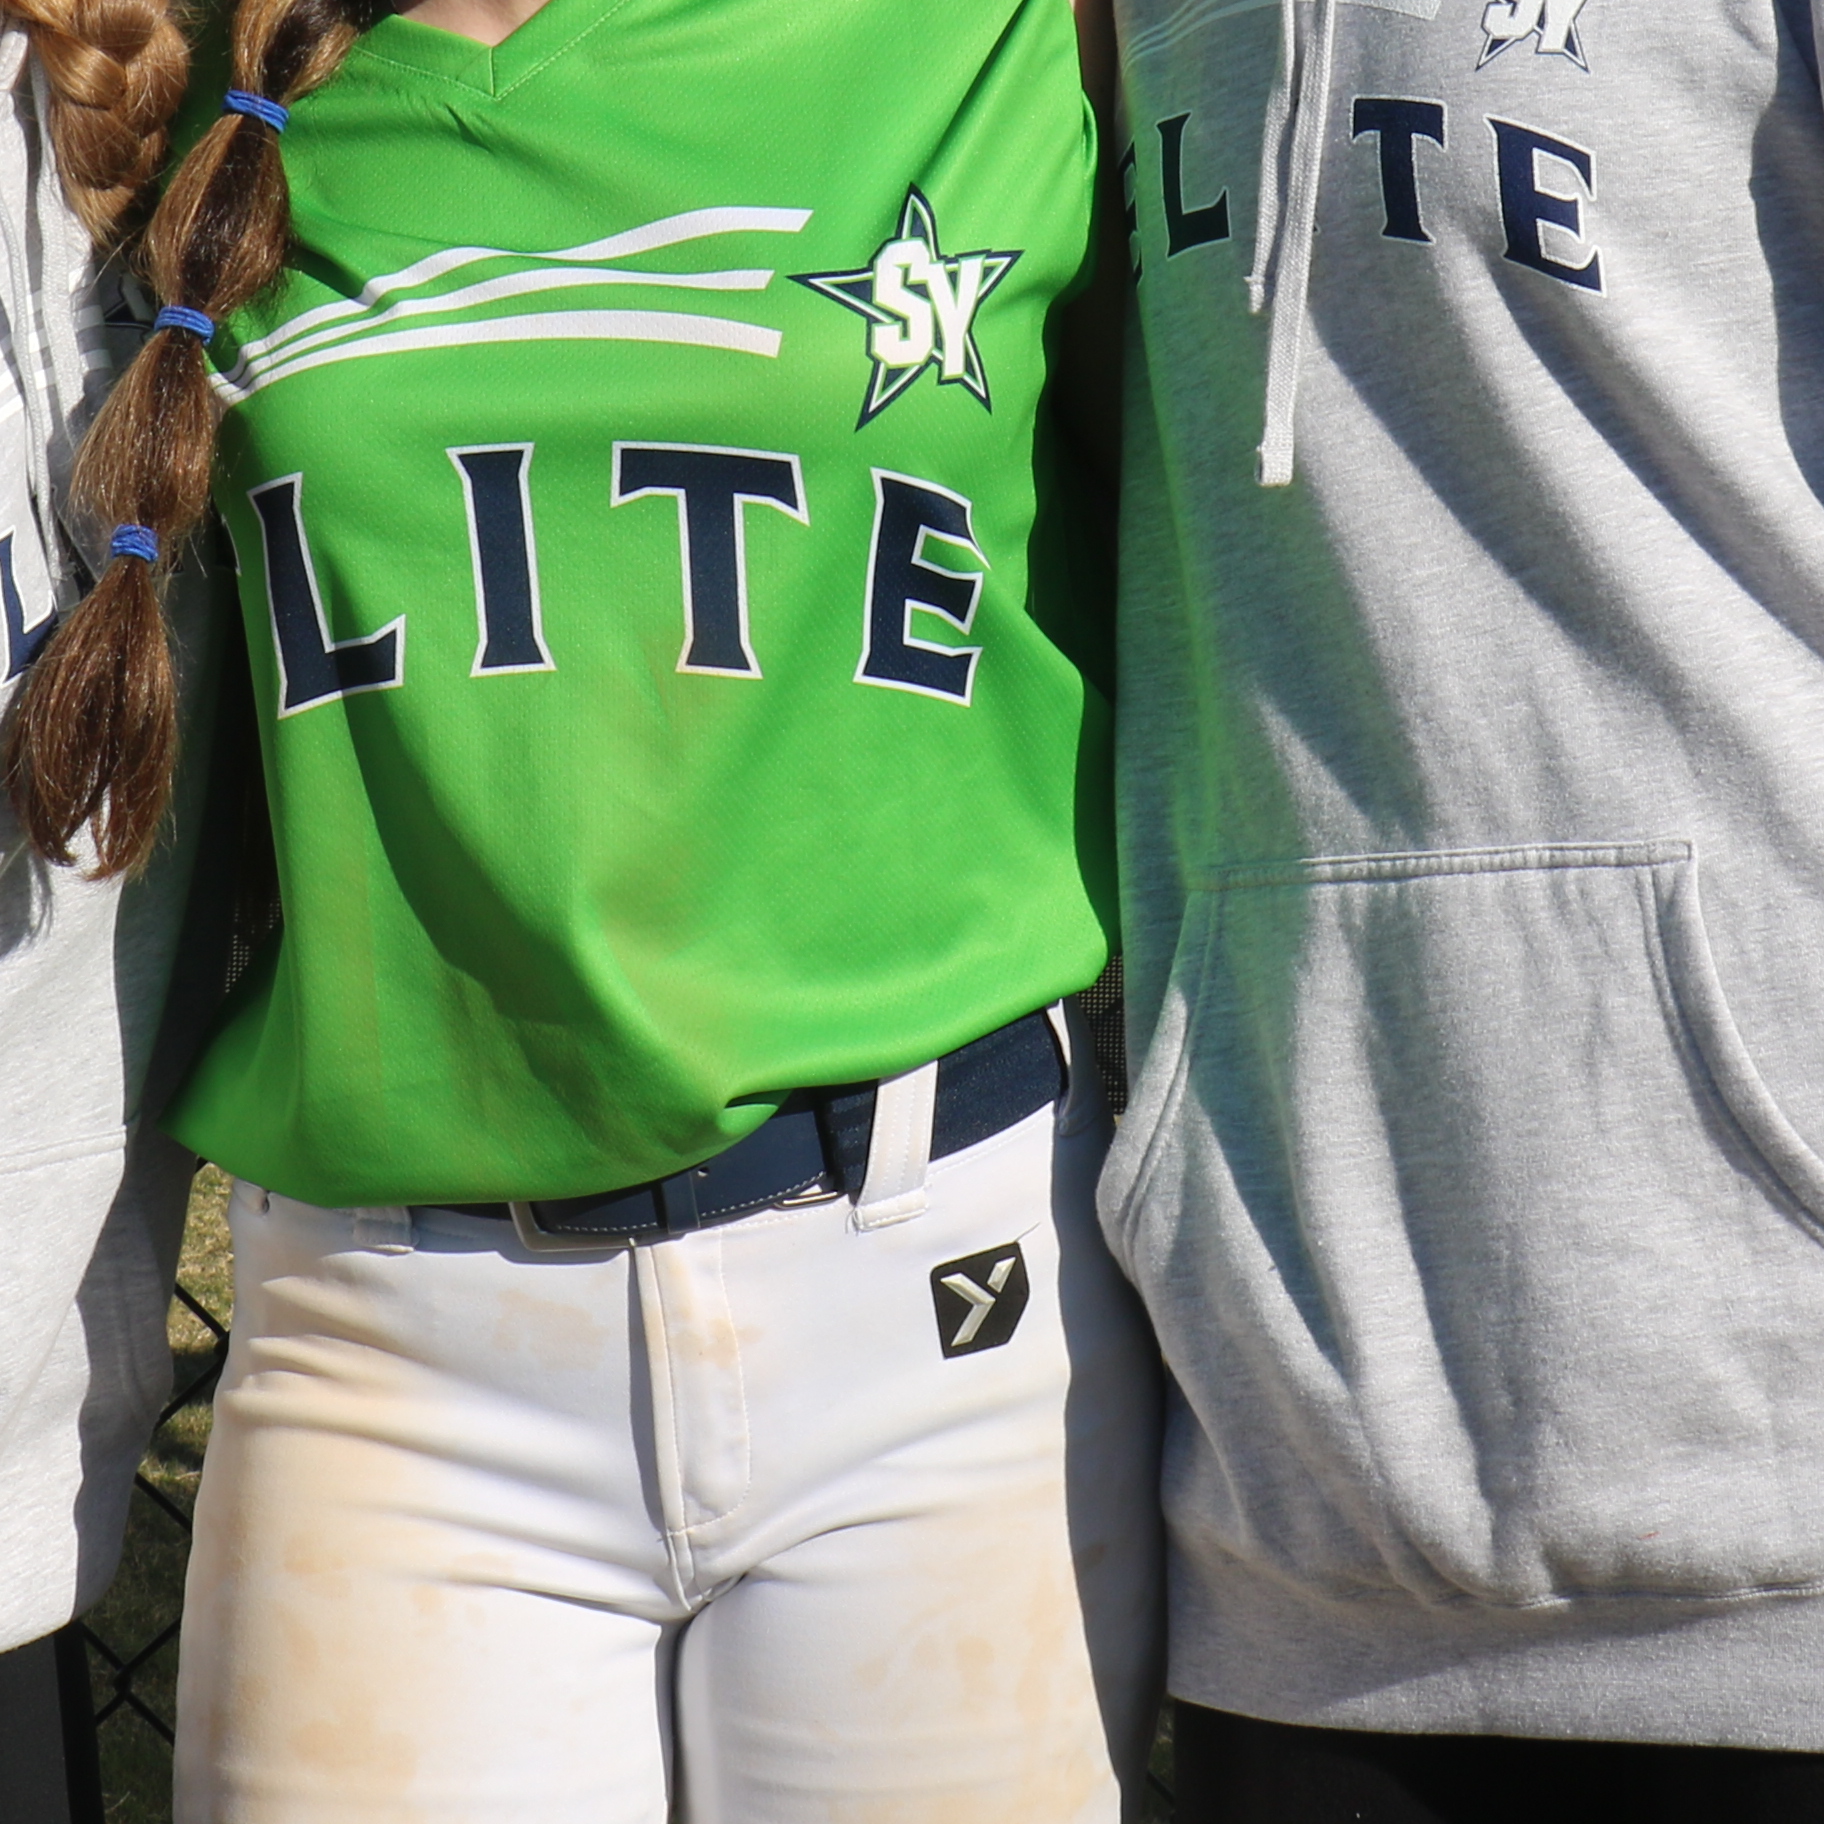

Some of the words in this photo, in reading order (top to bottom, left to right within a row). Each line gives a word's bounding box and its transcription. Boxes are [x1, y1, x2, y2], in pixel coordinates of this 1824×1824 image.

[1119, 94, 1607, 298] LTE
[869, 234, 987, 385] SY
[219, 440, 991, 721] LITE
